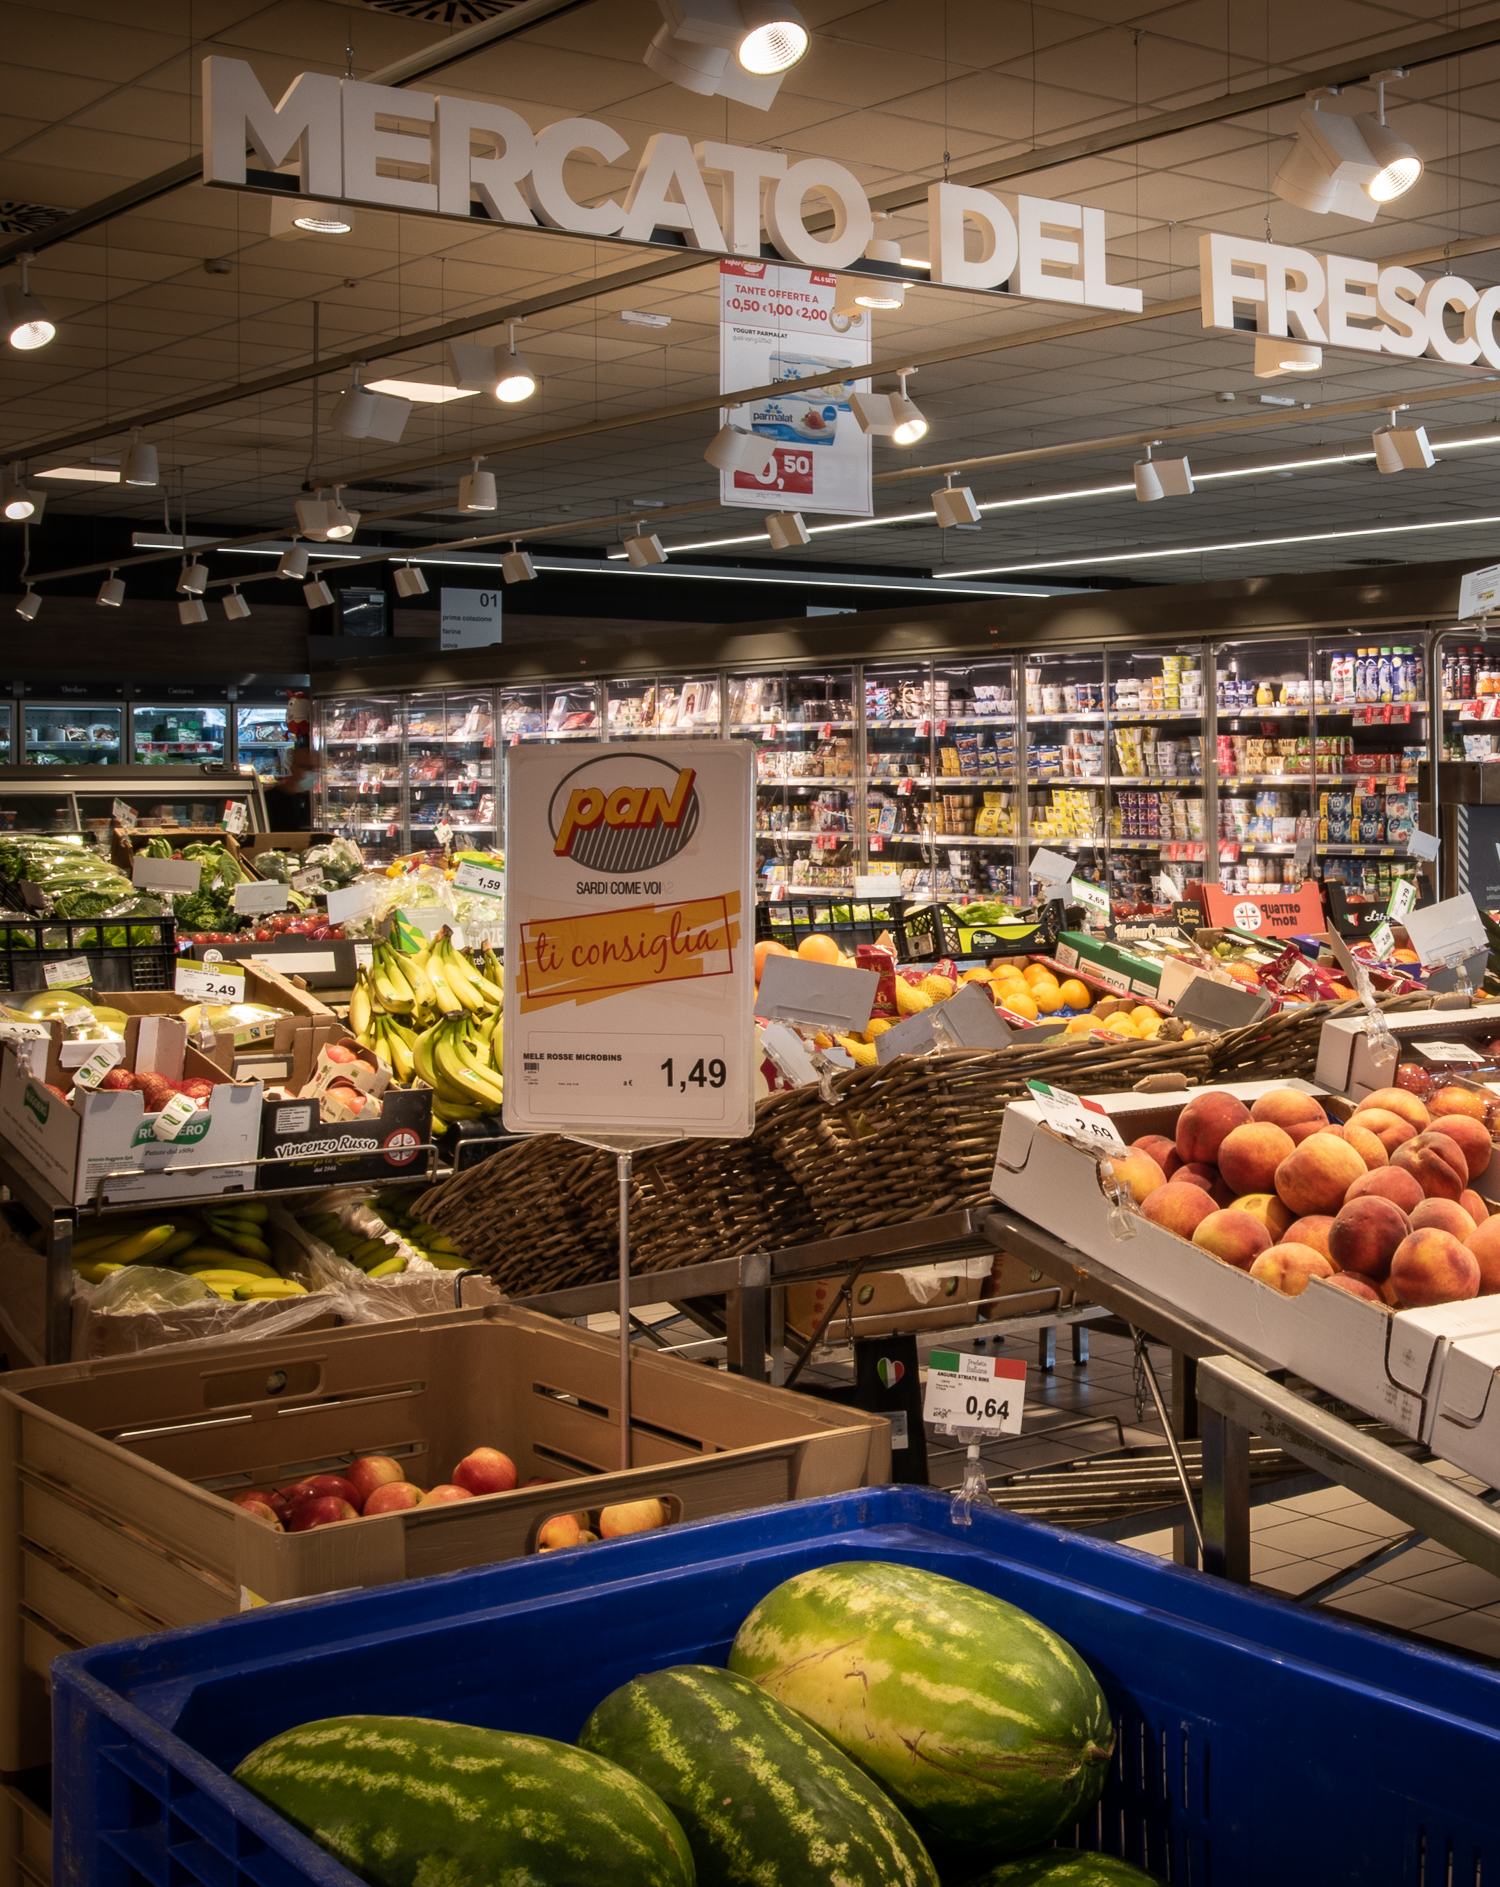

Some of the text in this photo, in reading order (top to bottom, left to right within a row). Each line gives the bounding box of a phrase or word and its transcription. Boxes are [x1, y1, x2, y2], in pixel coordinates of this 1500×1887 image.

[202, 55, 873, 269] MERCATO
[928, 182, 1143, 312] DEL
[735, 284, 819, 304] TANTE OFFERTE A
[733, 327, 788, 339] YOGURT PARMALAT
[753, 412, 793, 423] parmalat
[480, 593, 497, 608] 01
[462, 615, 492, 623] colazione
[478, 877, 501, 890] 1,59
[576, 881, 662, 895] SARDI COME VOI
[534, 910, 718, 975] ti consiglia
[202, 962, 220, 973] Bio
[205, 982, 236, 996] 2,49
[523, 1052, 623, 1062] MELE ROSSE MICROBINS
[660, 1057, 727, 1094] 1,49
[144, 1149, 166, 1157] Patate
[178, 1147, 195, 1155] 1889
[275, 1134, 378, 1158] Vincenzo Russo
[966, 1364, 988, 1374] Italiano
[937, 1371, 957, 1379] ANGURIE
[958, 1374, 978, 1382] STRIATE
[966, 1395, 1009, 1421] 0,64
